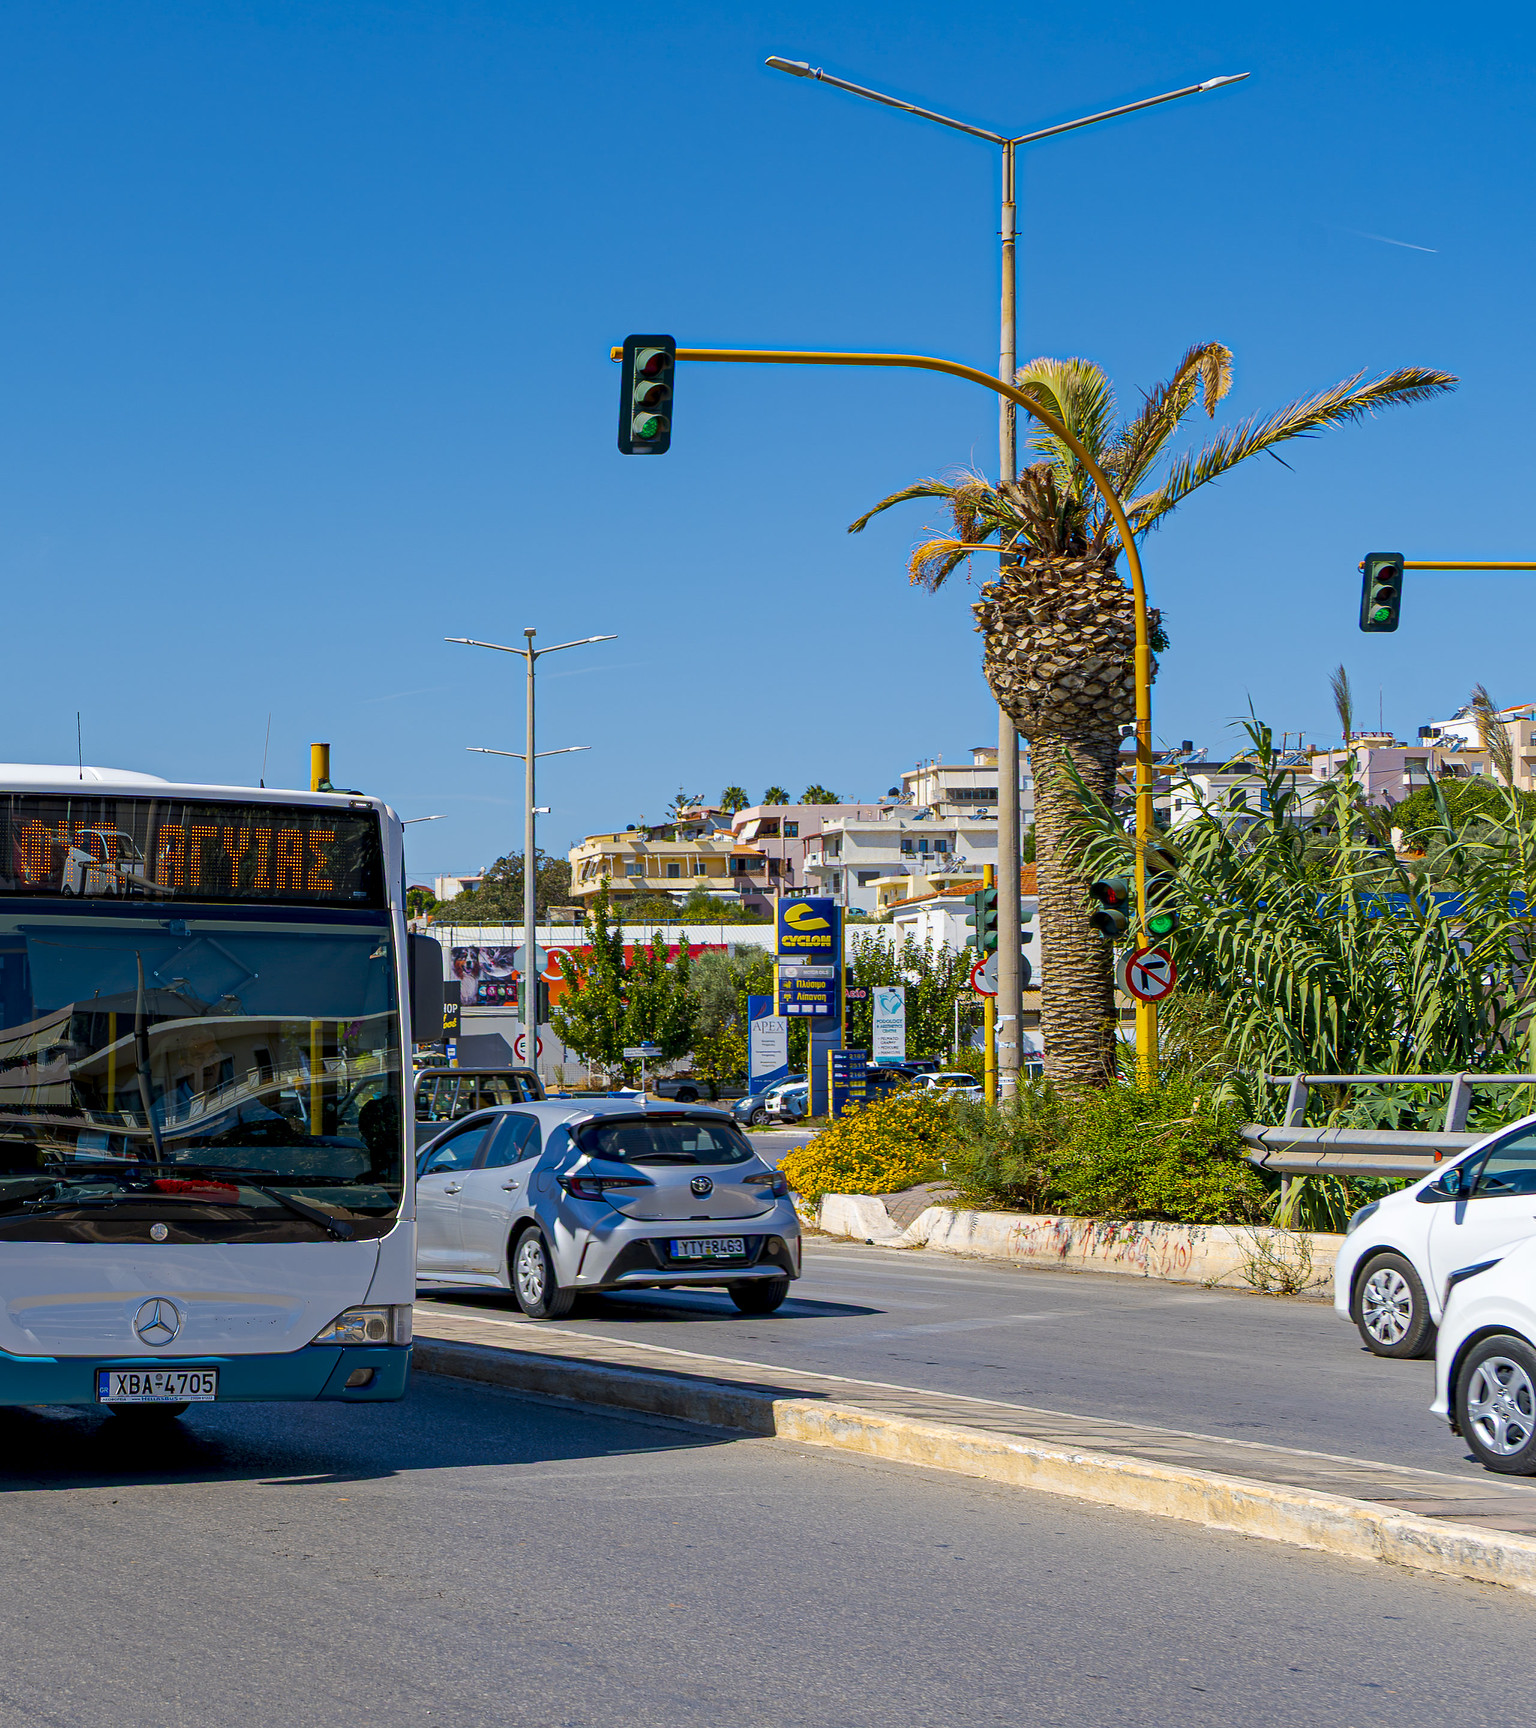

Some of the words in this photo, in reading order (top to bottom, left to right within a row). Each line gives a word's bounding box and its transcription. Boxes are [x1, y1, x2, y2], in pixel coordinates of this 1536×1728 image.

[158, 824, 335, 891] ΑΓΥΙΑΣ
[781, 935, 832, 947] CYCLON
[796, 980, 826, 989] Πλύσιμο
[796, 991, 827, 1002] Λίπανση
[115, 1373, 214, 1395] XBA-4705
